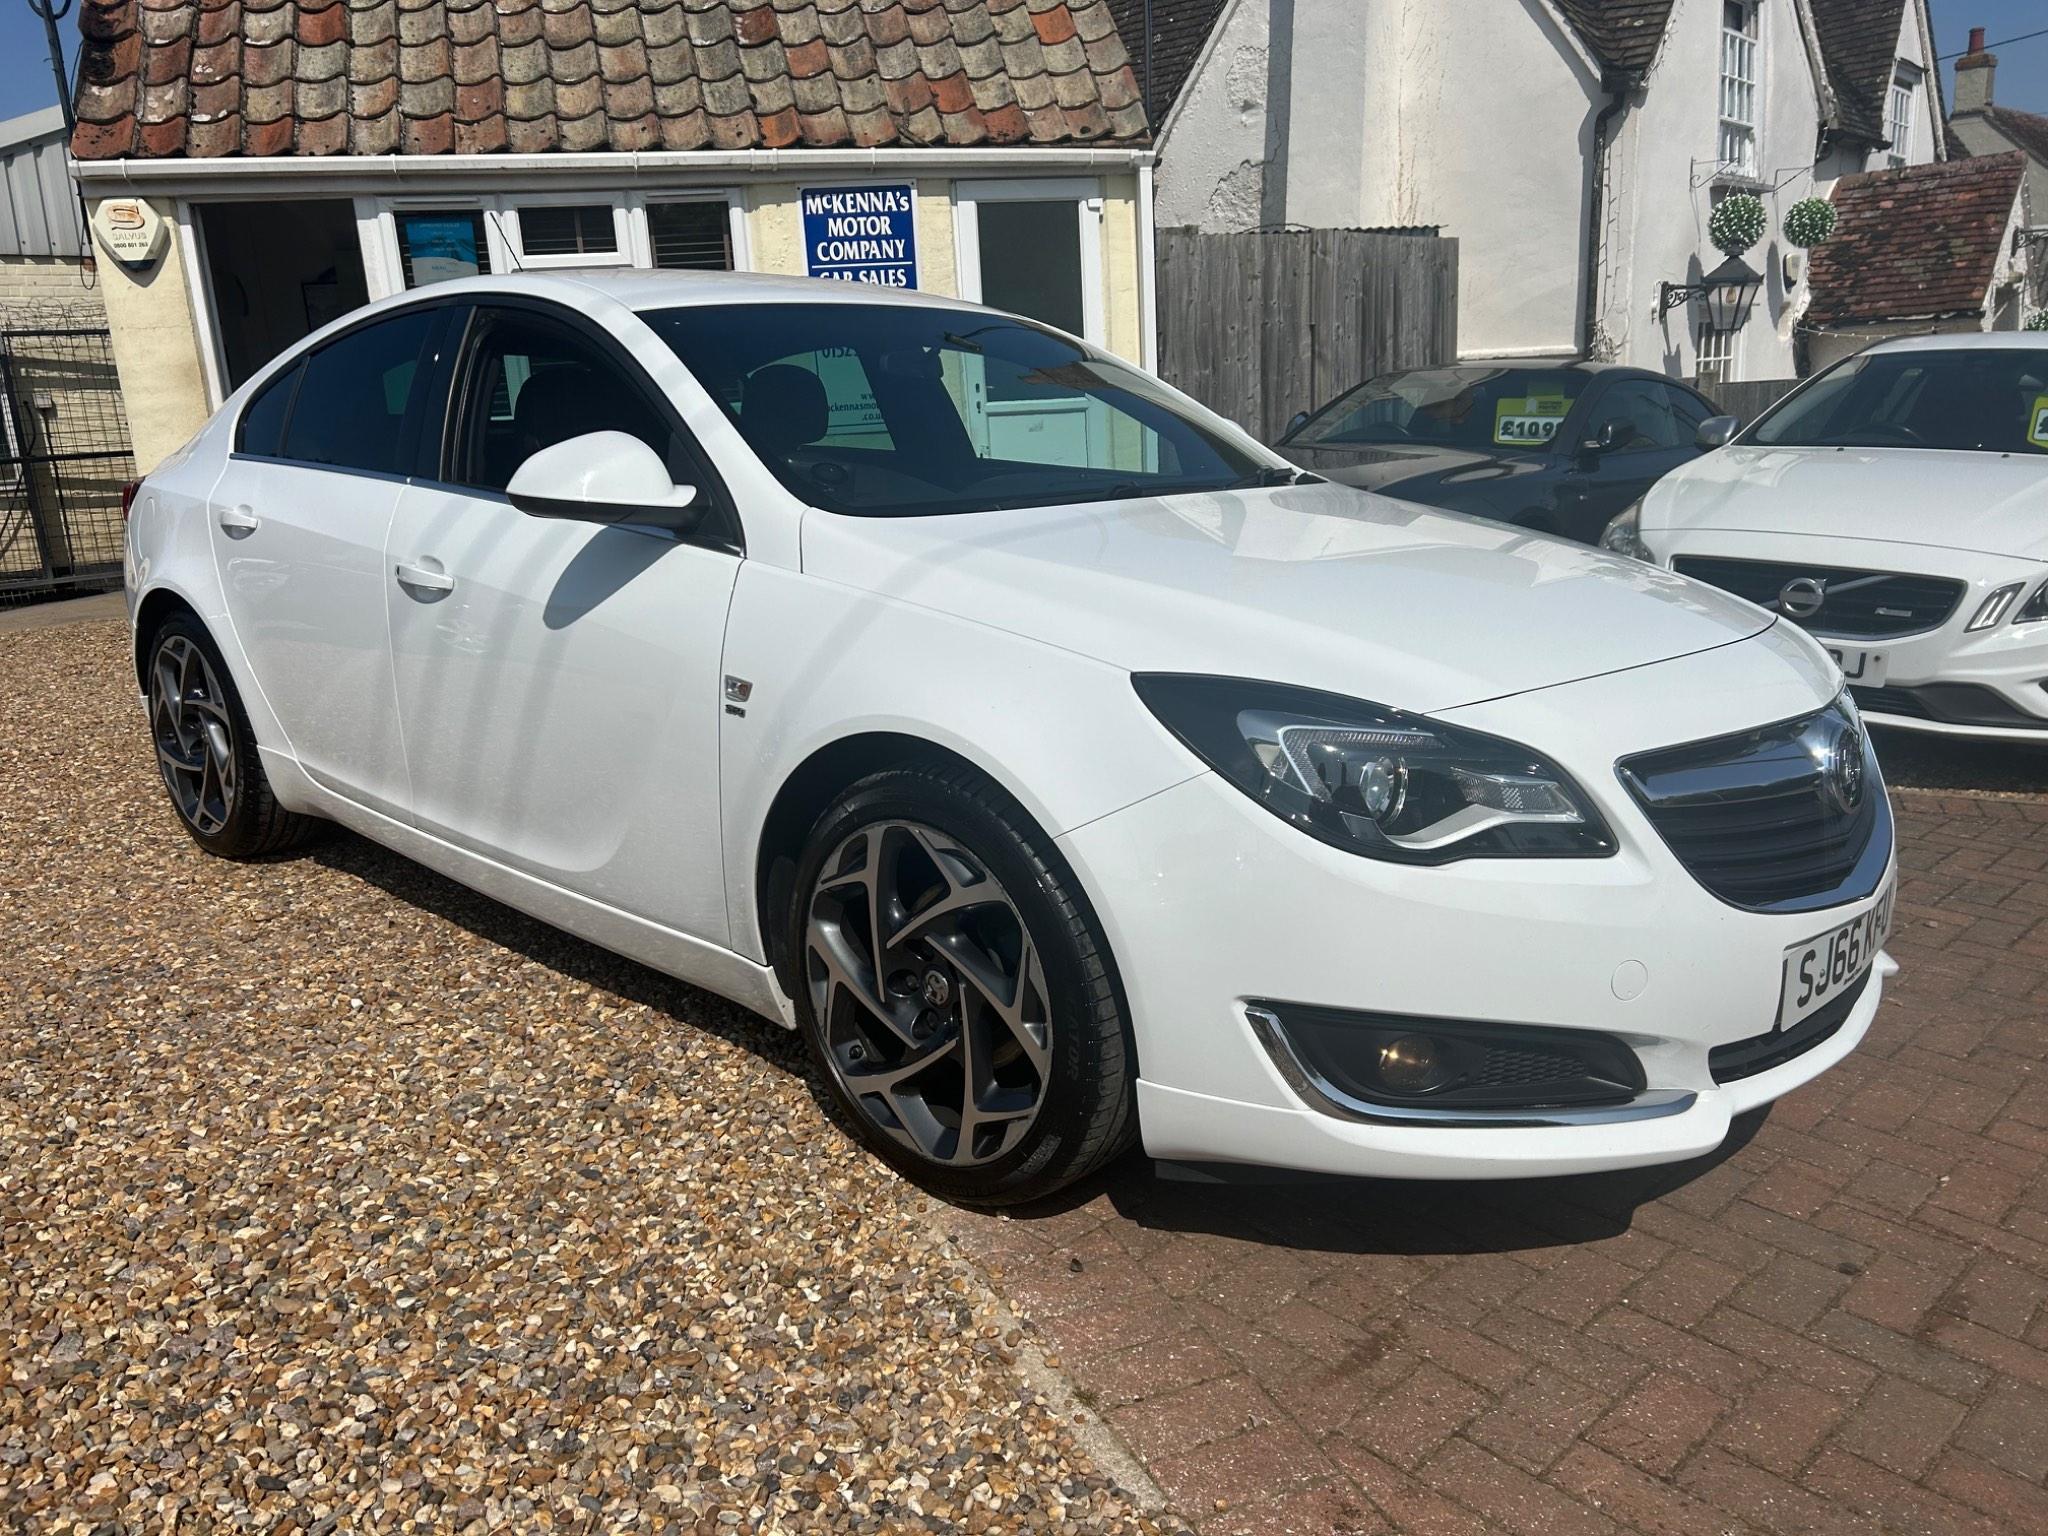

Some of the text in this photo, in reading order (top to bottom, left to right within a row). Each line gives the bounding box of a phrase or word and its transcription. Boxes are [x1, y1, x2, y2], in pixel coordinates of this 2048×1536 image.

[827, 215, 893, 237] MOTOR
[816, 239, 906, 262] COMPANY
[858, 268, 907, 287] SALES
[1501, 420, 1563, 437] £109
[1796, 918, 1862, 1009] SJ66
